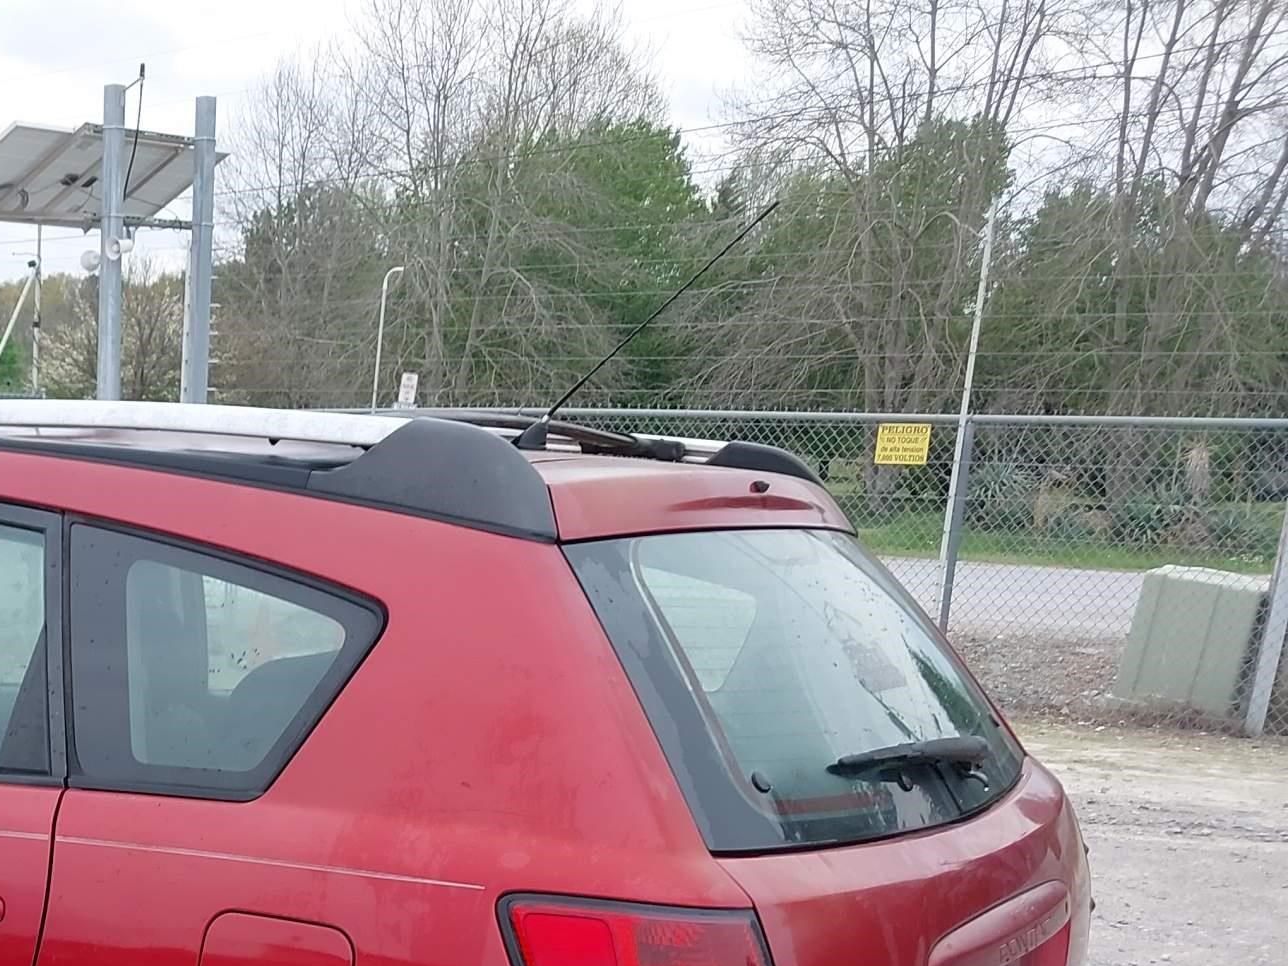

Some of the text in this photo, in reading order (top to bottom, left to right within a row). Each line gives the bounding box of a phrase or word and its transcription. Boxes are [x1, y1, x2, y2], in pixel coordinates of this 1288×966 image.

[881, 425, 929, 434] PELIGRO
[886, 436, 920, 444] NO TOQUE
